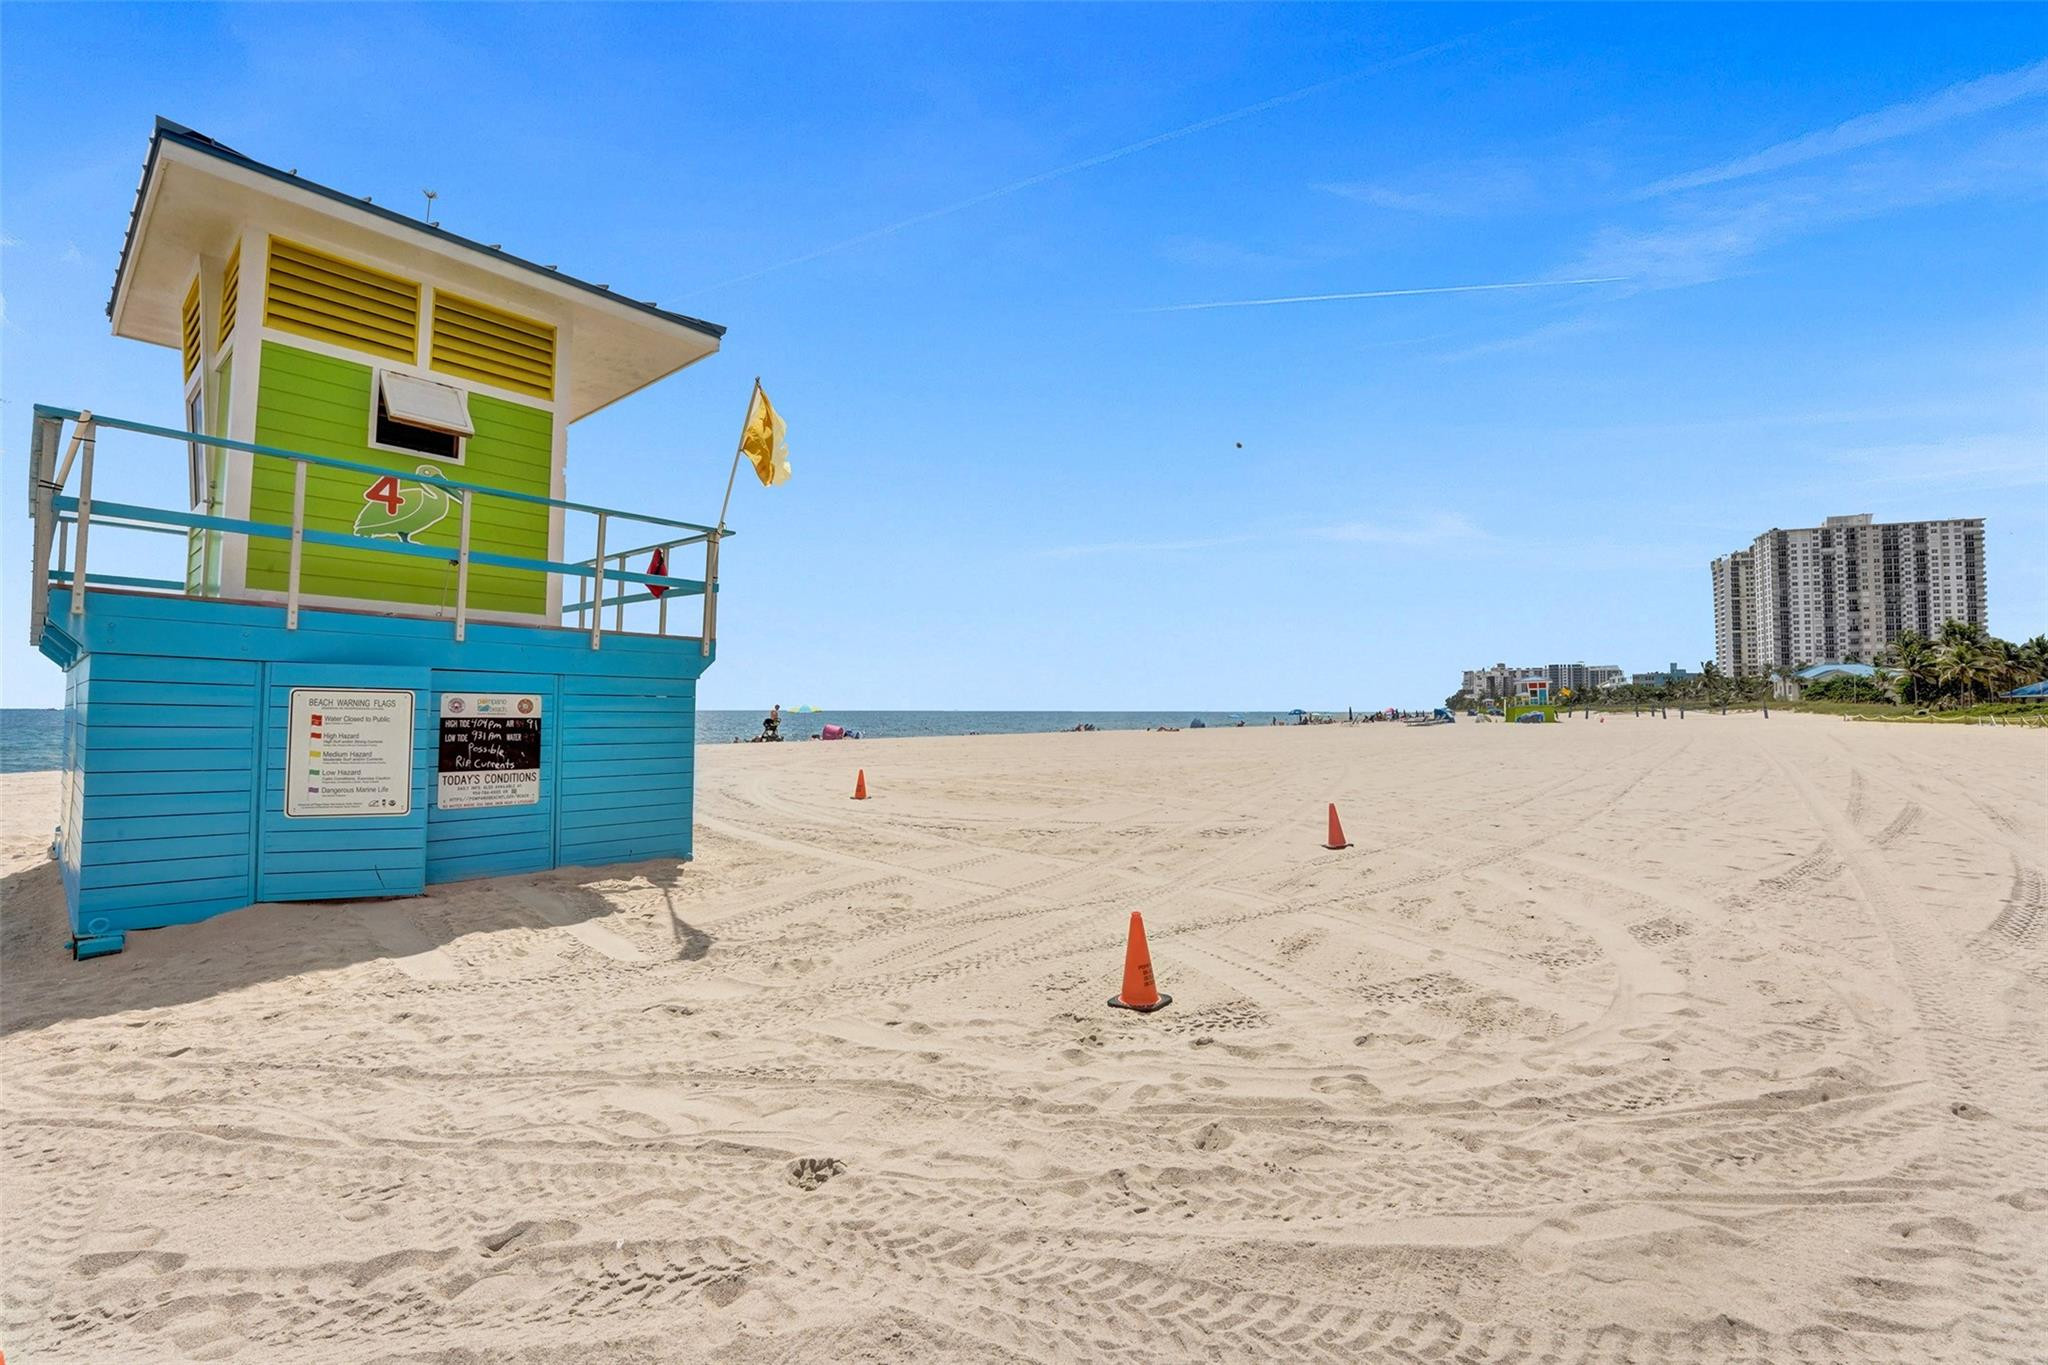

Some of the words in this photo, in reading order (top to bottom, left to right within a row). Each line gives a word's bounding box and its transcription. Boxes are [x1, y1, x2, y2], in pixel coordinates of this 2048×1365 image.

[364, 476, 405, 516] 4
[308, 698, 334, 707] BEACH
[336, 698, 370, 708] WARNING
[374, 700, 396, 708] FLAGS
[460, 720, 471, 728] TIDE
[444, 734, 456, 742] LOW
[457, 734, 468, 742] TIDE
[442, 774, 480, 786] TODAY'S
[484, 772, 537, 784] CONDITIONS
